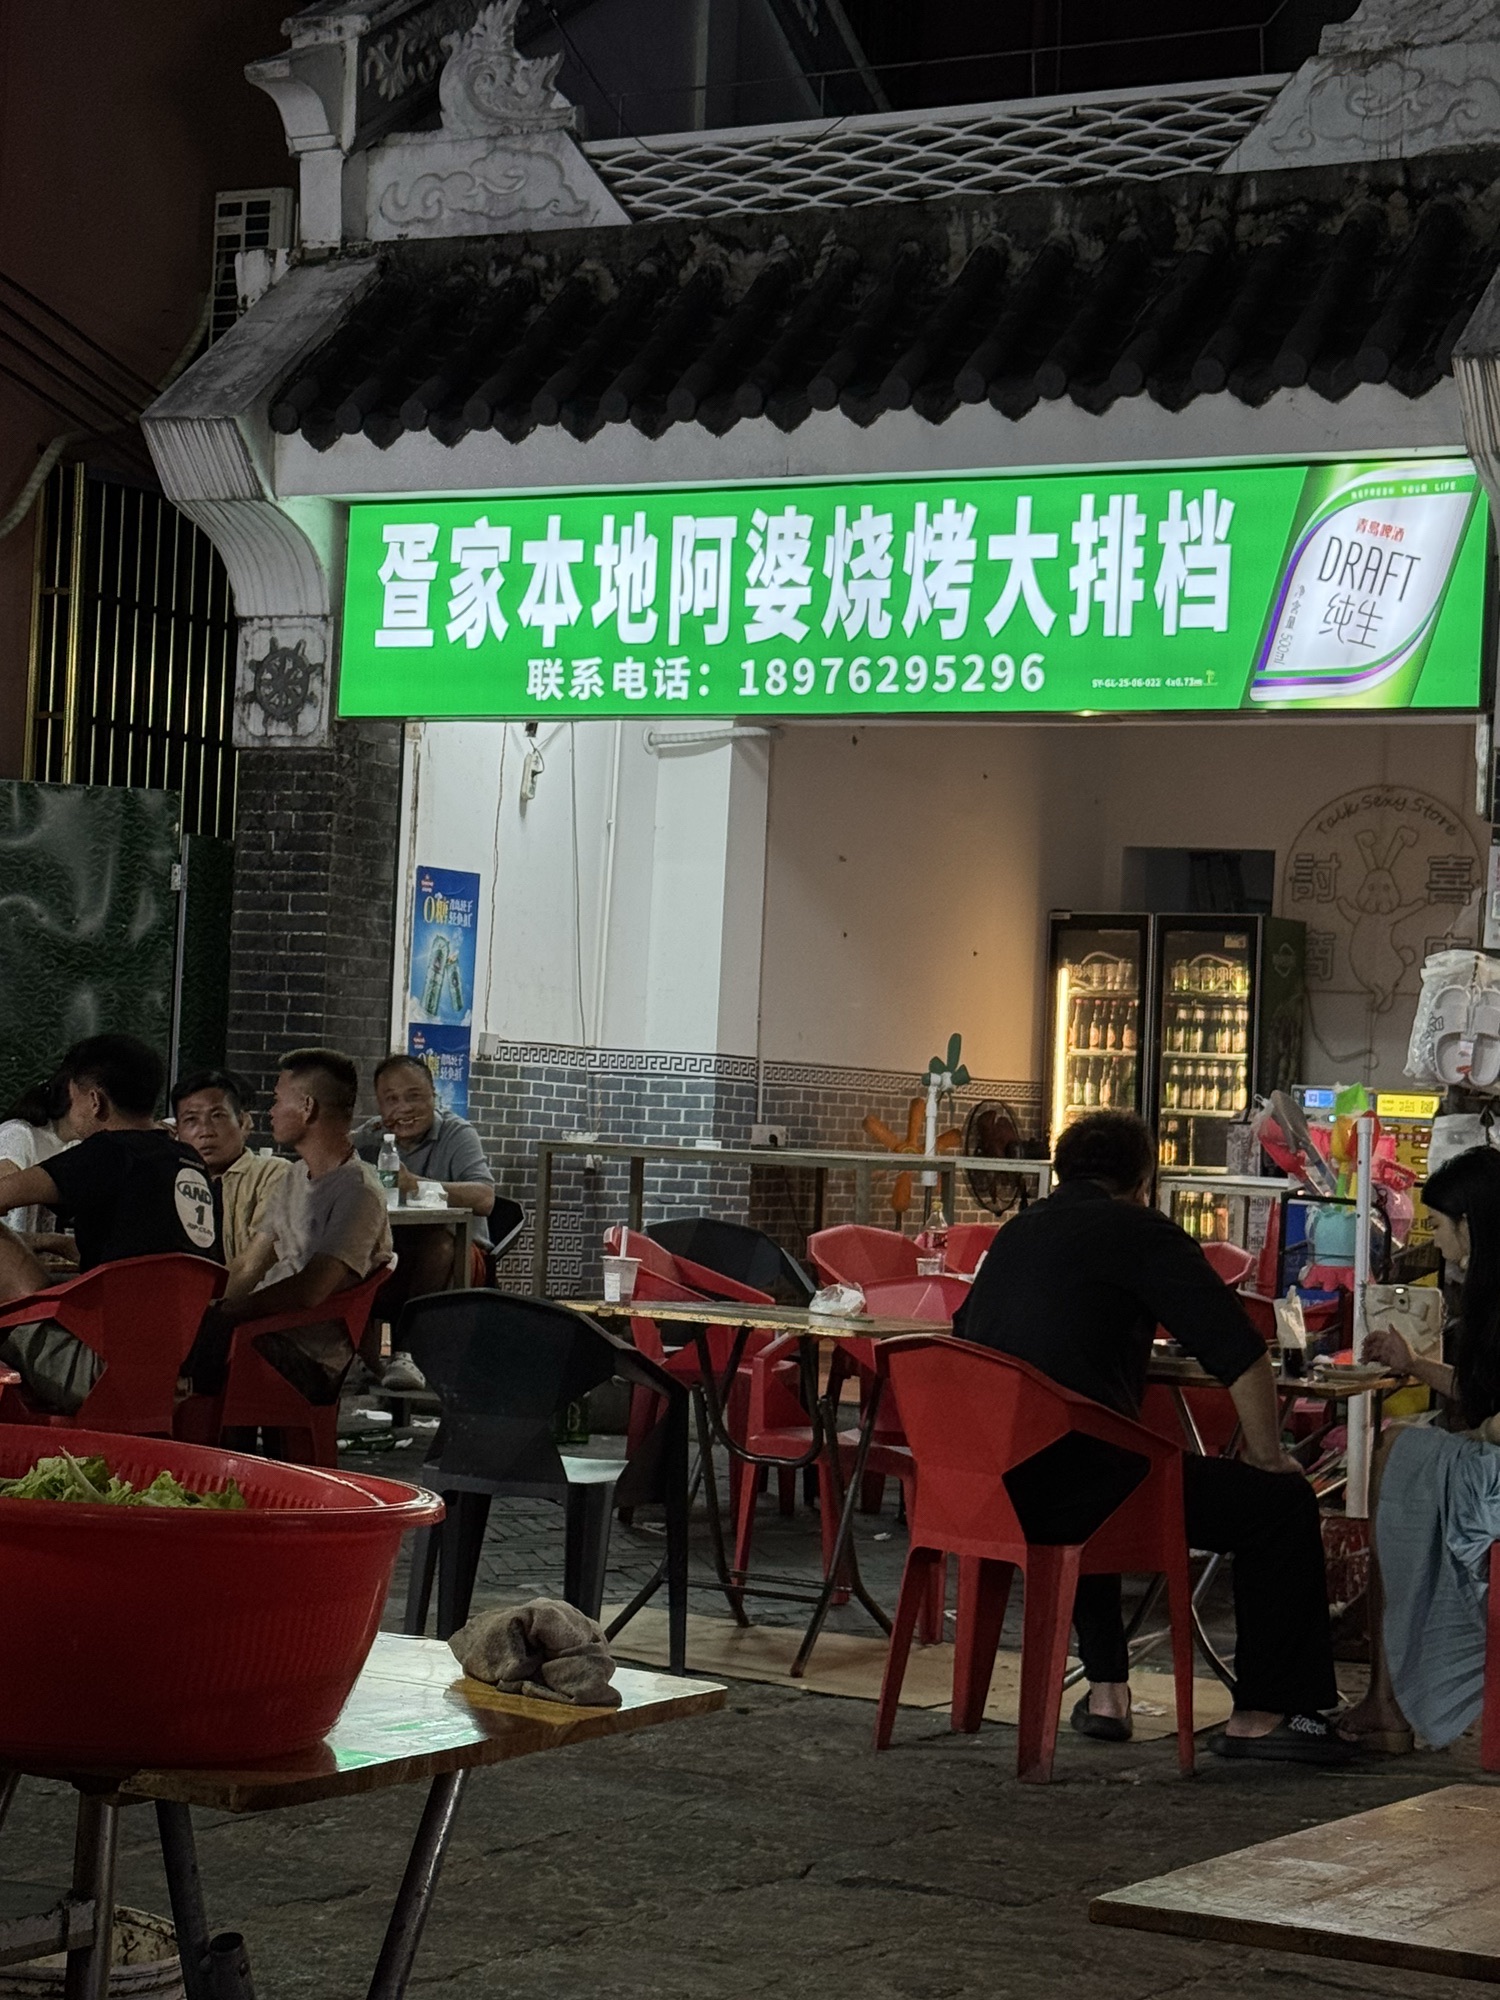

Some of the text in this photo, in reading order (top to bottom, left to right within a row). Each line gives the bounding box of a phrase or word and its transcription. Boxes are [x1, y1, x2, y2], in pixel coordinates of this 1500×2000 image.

[374, 488, 1235, 649] 疍家本地阿婆烧烤大排档
[1317, 536, 1422, 603] DRAFT
[1318, 592, 1384, 649] 纯生
[1315, 794, 1458, 837] Talk Sexy Store
[182, 1184, 212, 1205] AND
[195, 1204, 205, 1226] 1
